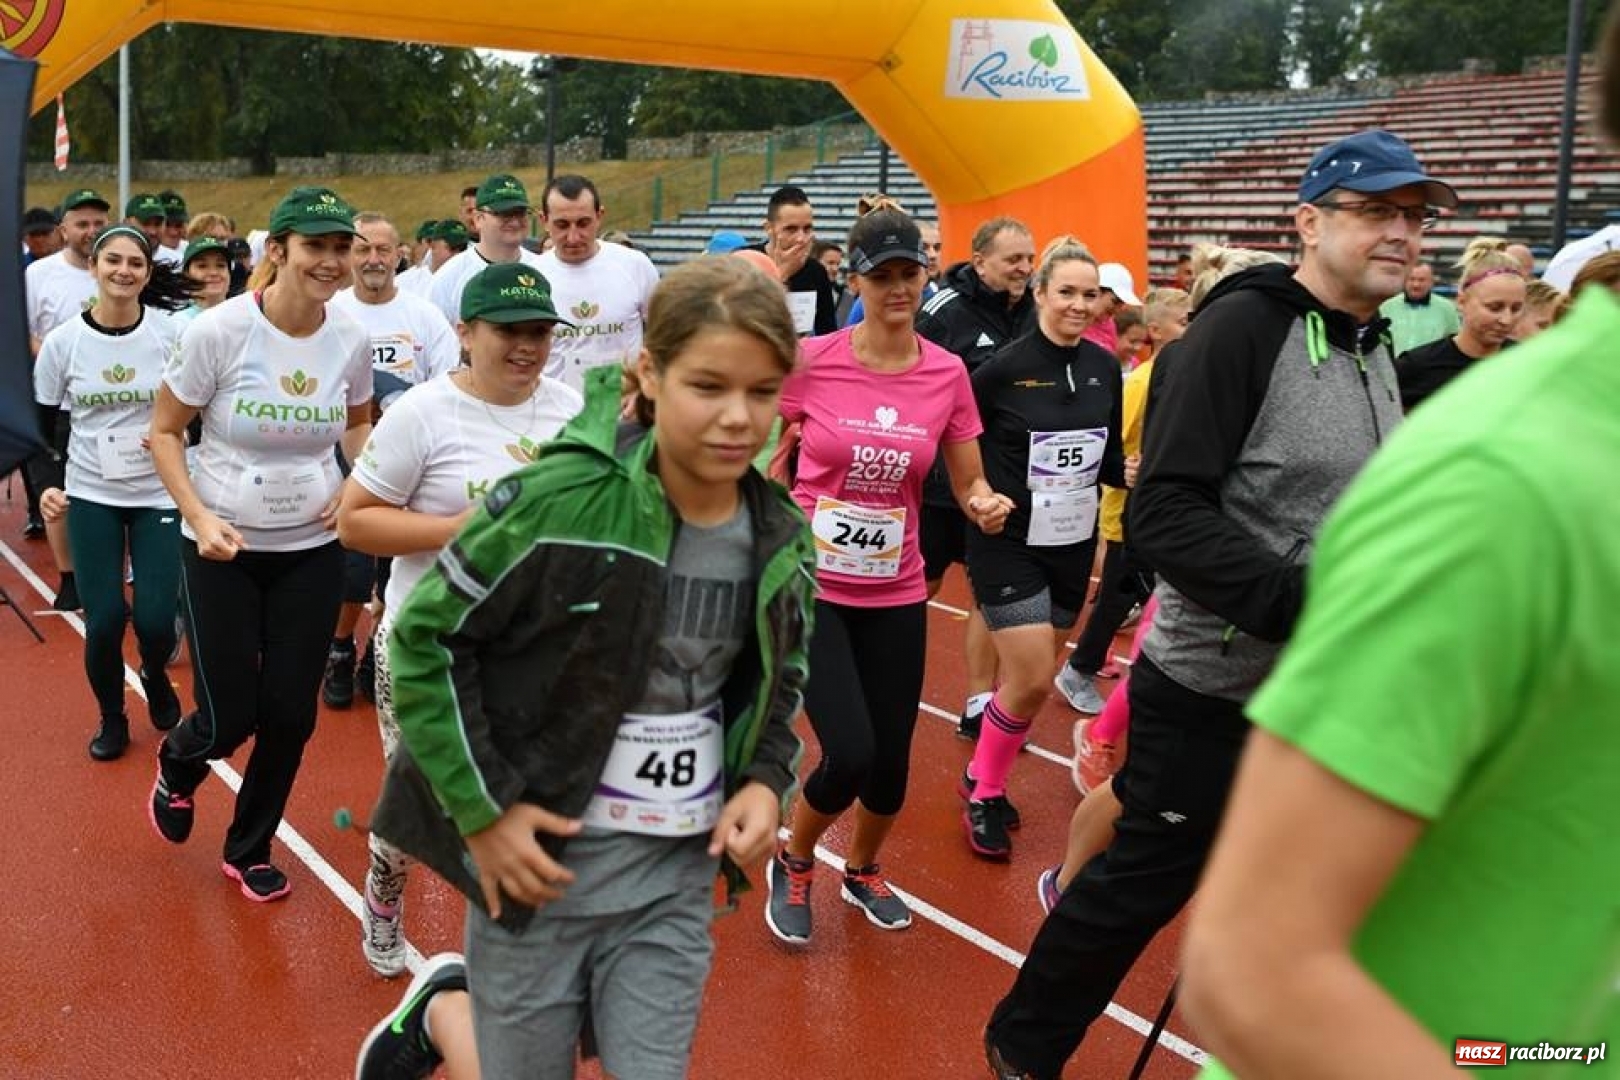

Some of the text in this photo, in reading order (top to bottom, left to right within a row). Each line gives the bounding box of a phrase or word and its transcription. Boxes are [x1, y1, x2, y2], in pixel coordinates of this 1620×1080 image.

[235, 398, 345, 423] KATOLIK
[851, 444, 912, 467] 10/06
[1057, 447, 1083, 468] 55
[848, 461, 907, 481] 2018
[832, 522, 886, 550] 244
[635, 749, 697, 788] 48
